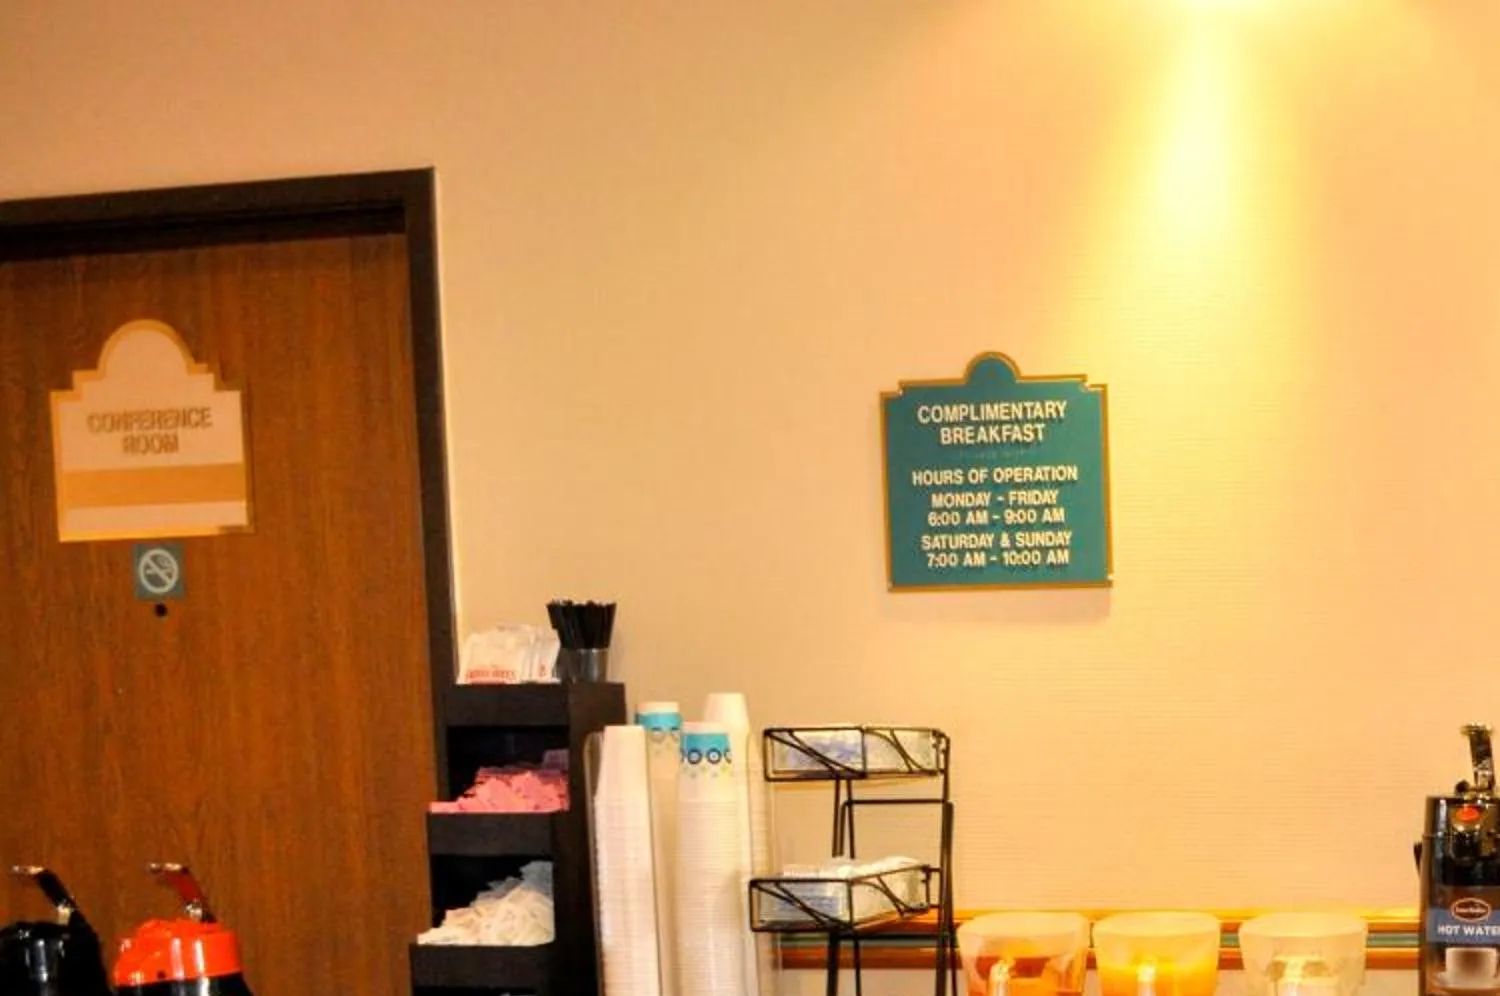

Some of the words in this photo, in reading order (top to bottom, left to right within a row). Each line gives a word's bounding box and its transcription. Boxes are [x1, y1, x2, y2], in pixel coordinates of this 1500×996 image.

[86, 406, 213, 434] CONFERENCE
[917, 400, 1067, 424] COMPLIMENTARY
[122, 433, 179, 455] ROOM
[940, 423, 1046, 445] BREAKFAST
[912, 469, 963, 486] HOURS
[968, 468, 988, 483] OF
[993, 465, 1078, 483] OPERATION
[931, 492, 991, 508] MONDAY
[1008, 490, 1059, 505] FRIDAY
[927, 511, 960, 526] 6:00
[966, 510, 988, 525] AM
[1004, 509, 1036, 524] 9:00
[1042, 508, 1065, 523] AM
[921, 533, 994, 551] SATURDAY
[1000, 533, 1012, 548] &
[1015, 531, 1073, 547] SUNDAY
[926, 552, 959, 568] 7:00
[963, 551, 985, 567] AM
[1003, 550, 1041, 566] 10:00
[1046, 549, 1070, 565] AM
[1437, 924, 1460, 936] HOT
